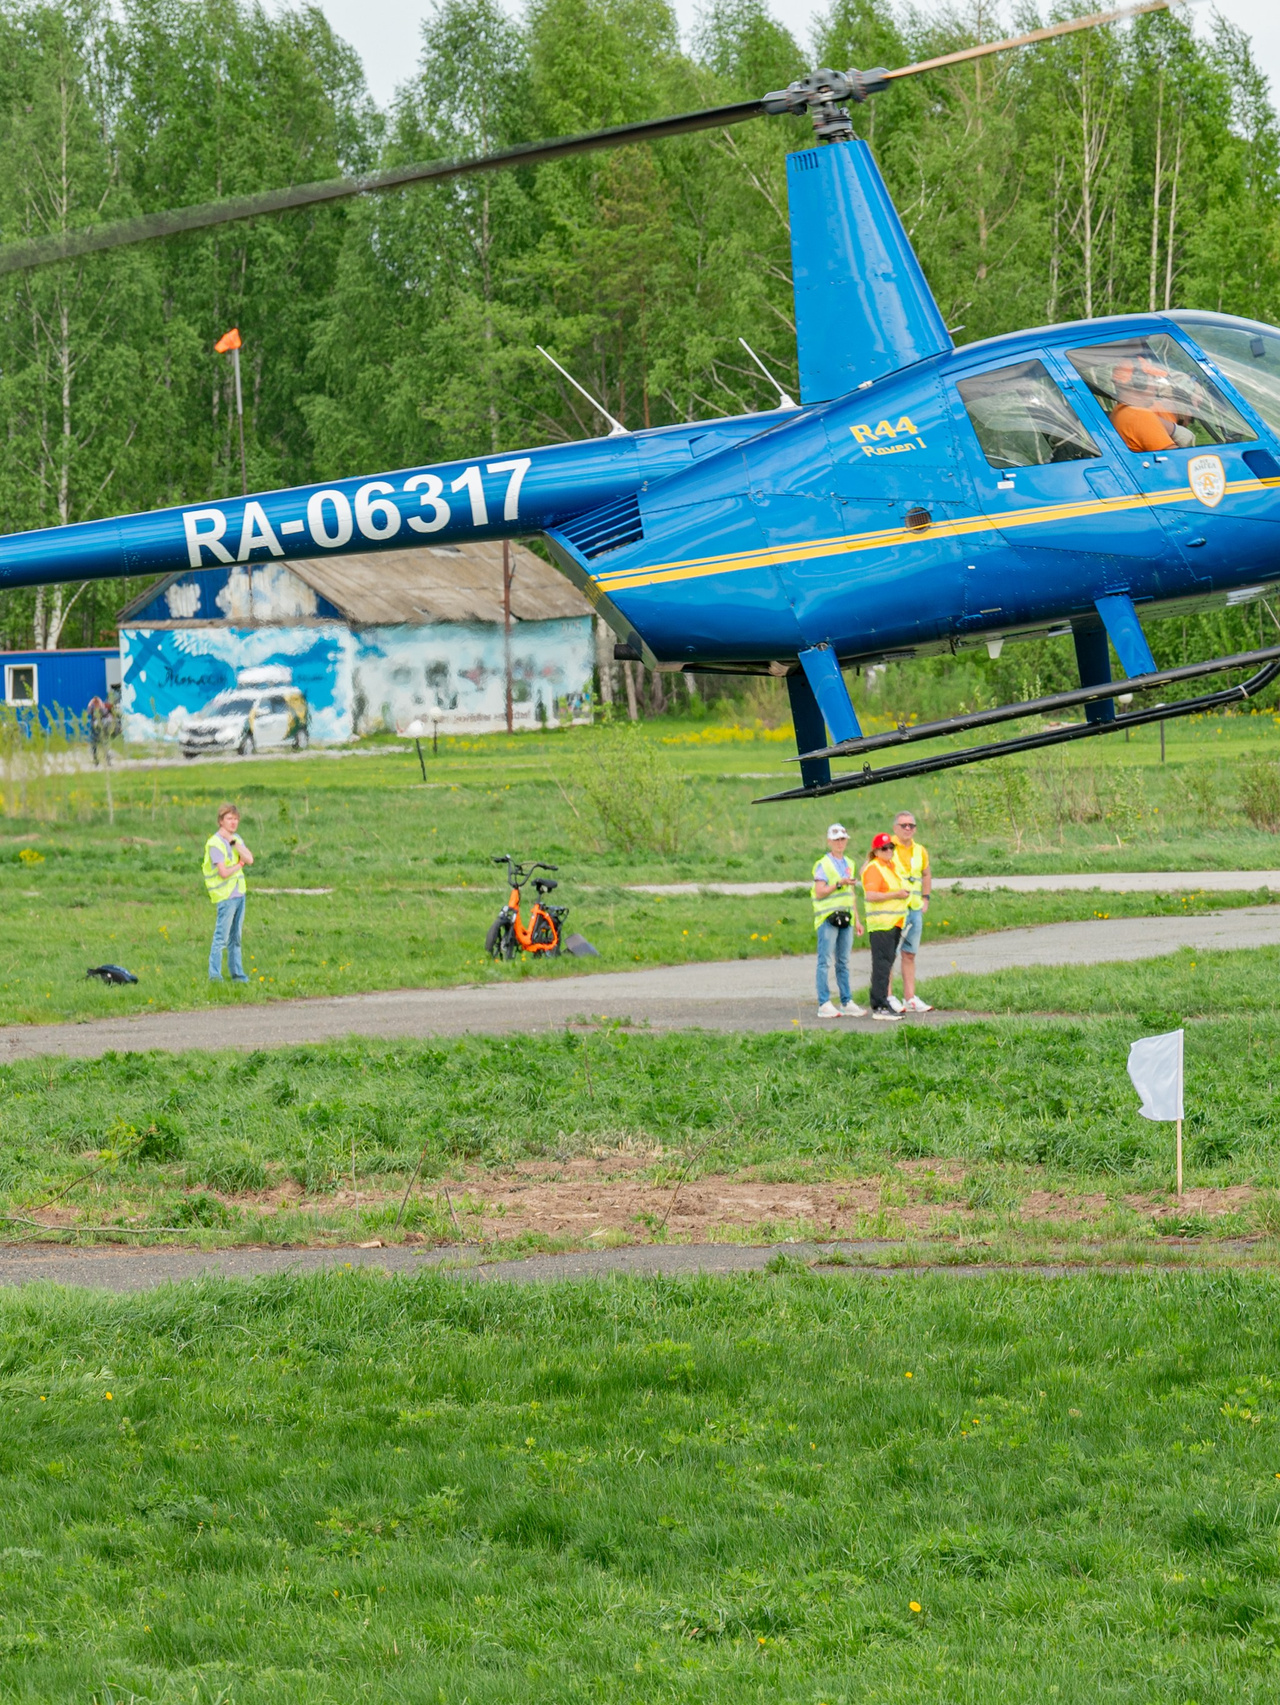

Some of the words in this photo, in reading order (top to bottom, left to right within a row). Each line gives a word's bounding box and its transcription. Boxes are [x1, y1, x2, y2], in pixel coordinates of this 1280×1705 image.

[849, 416, 919, 443] R44
[861, 443, 916, 457] Raven
[182, 457, 532, 568] RA-06317
